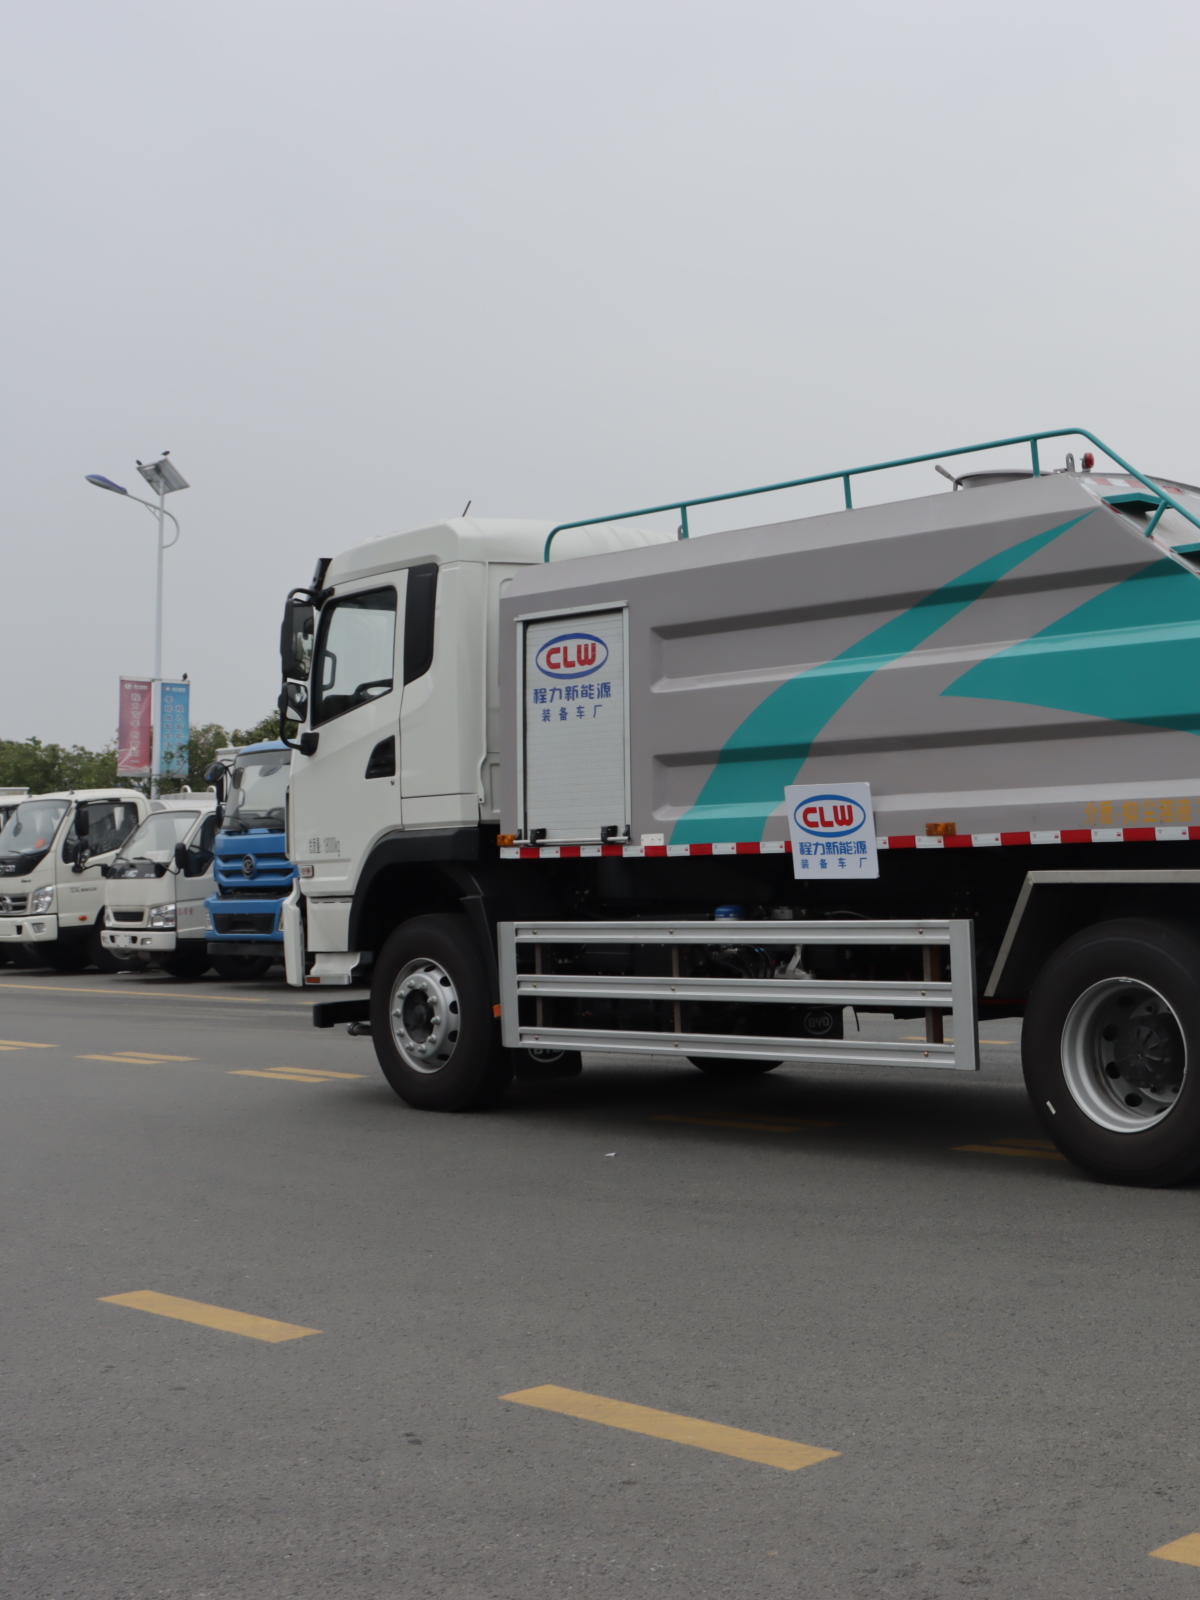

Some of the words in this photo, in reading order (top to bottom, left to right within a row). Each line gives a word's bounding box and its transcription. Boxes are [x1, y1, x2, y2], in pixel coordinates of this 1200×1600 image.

[546, 643, 597, 670] CLW
[533, 682, 611, 704] 程力新能源
[542, 704, 603, 722] 装备车厂
[802, 805, 854, 828] CLW
[798, 840, 868, 856] 程力新能源
[801, 857, 868, 870] 装备车厂
[808, 1016, 830, 1027] BYD
